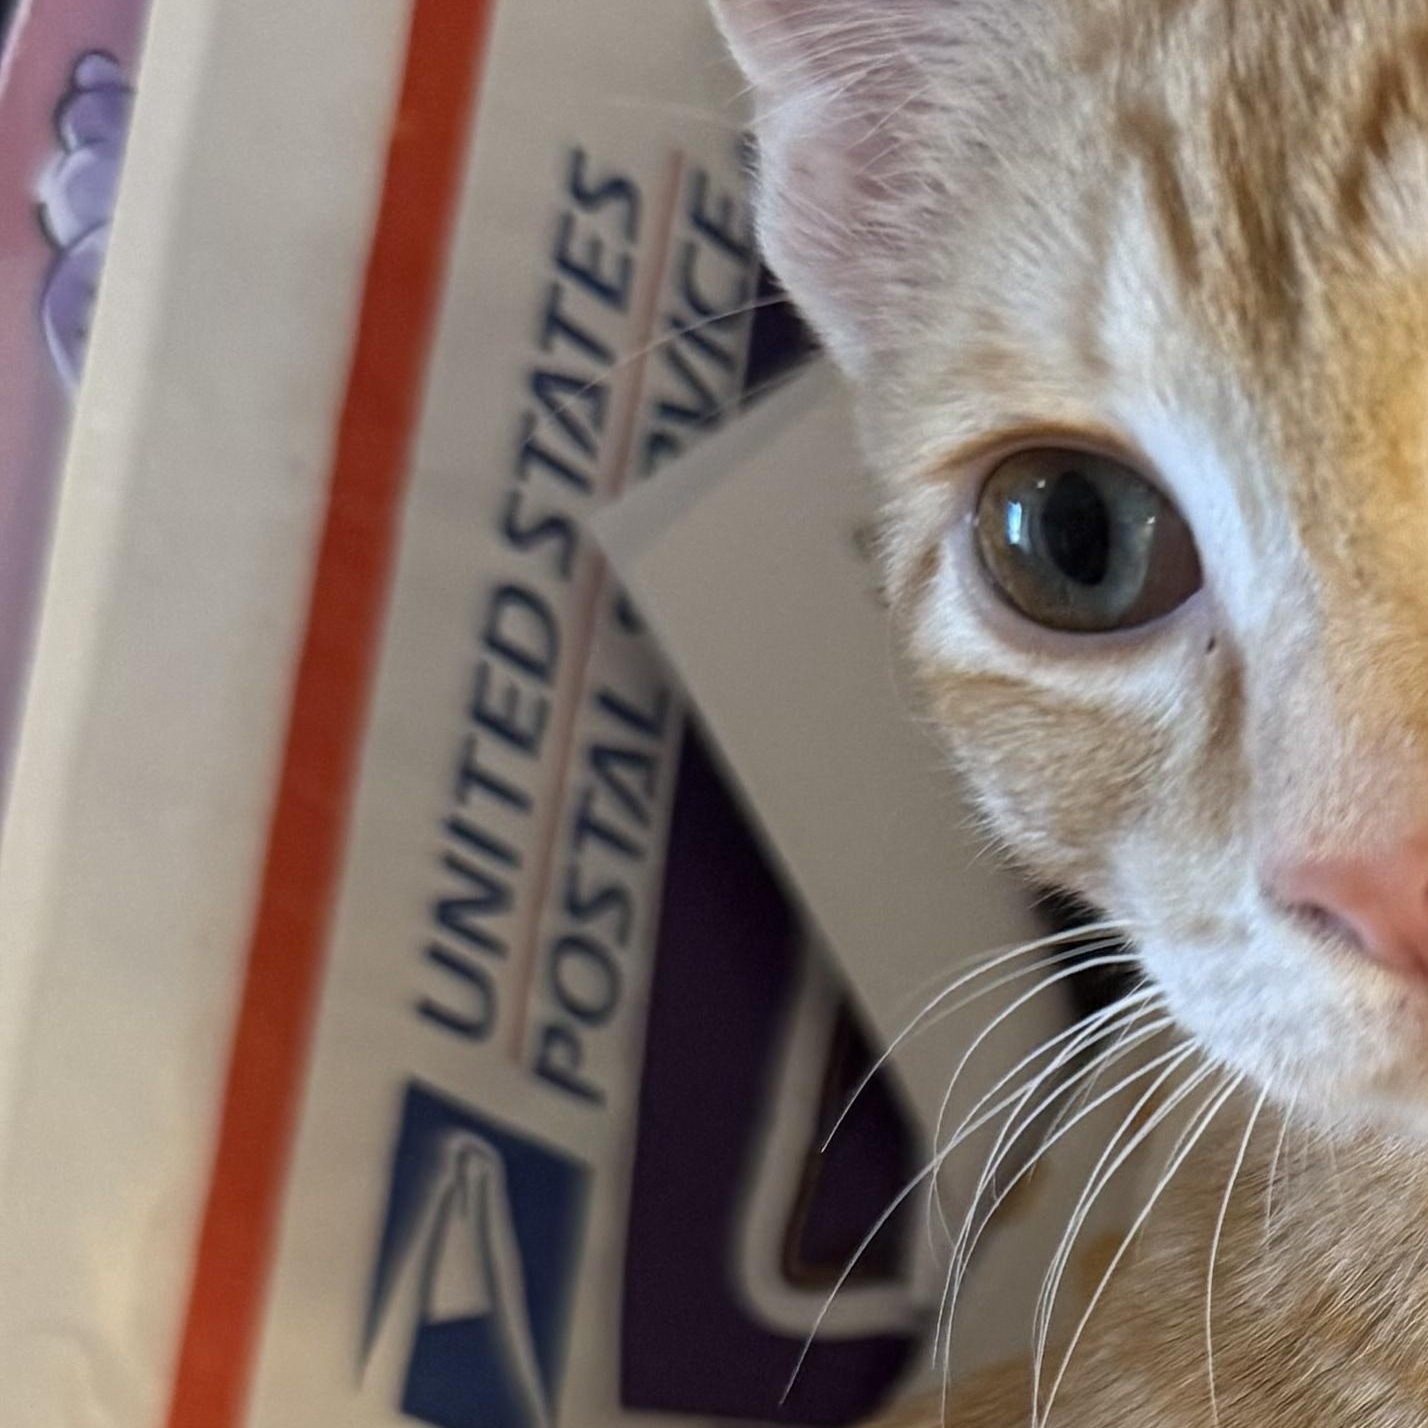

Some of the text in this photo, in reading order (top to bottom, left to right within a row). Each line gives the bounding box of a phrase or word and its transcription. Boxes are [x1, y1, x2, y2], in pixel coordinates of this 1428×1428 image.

[412, 144, 642, 1044] UNITED STATES
[532, 686, 670, 1108] POSTAL
